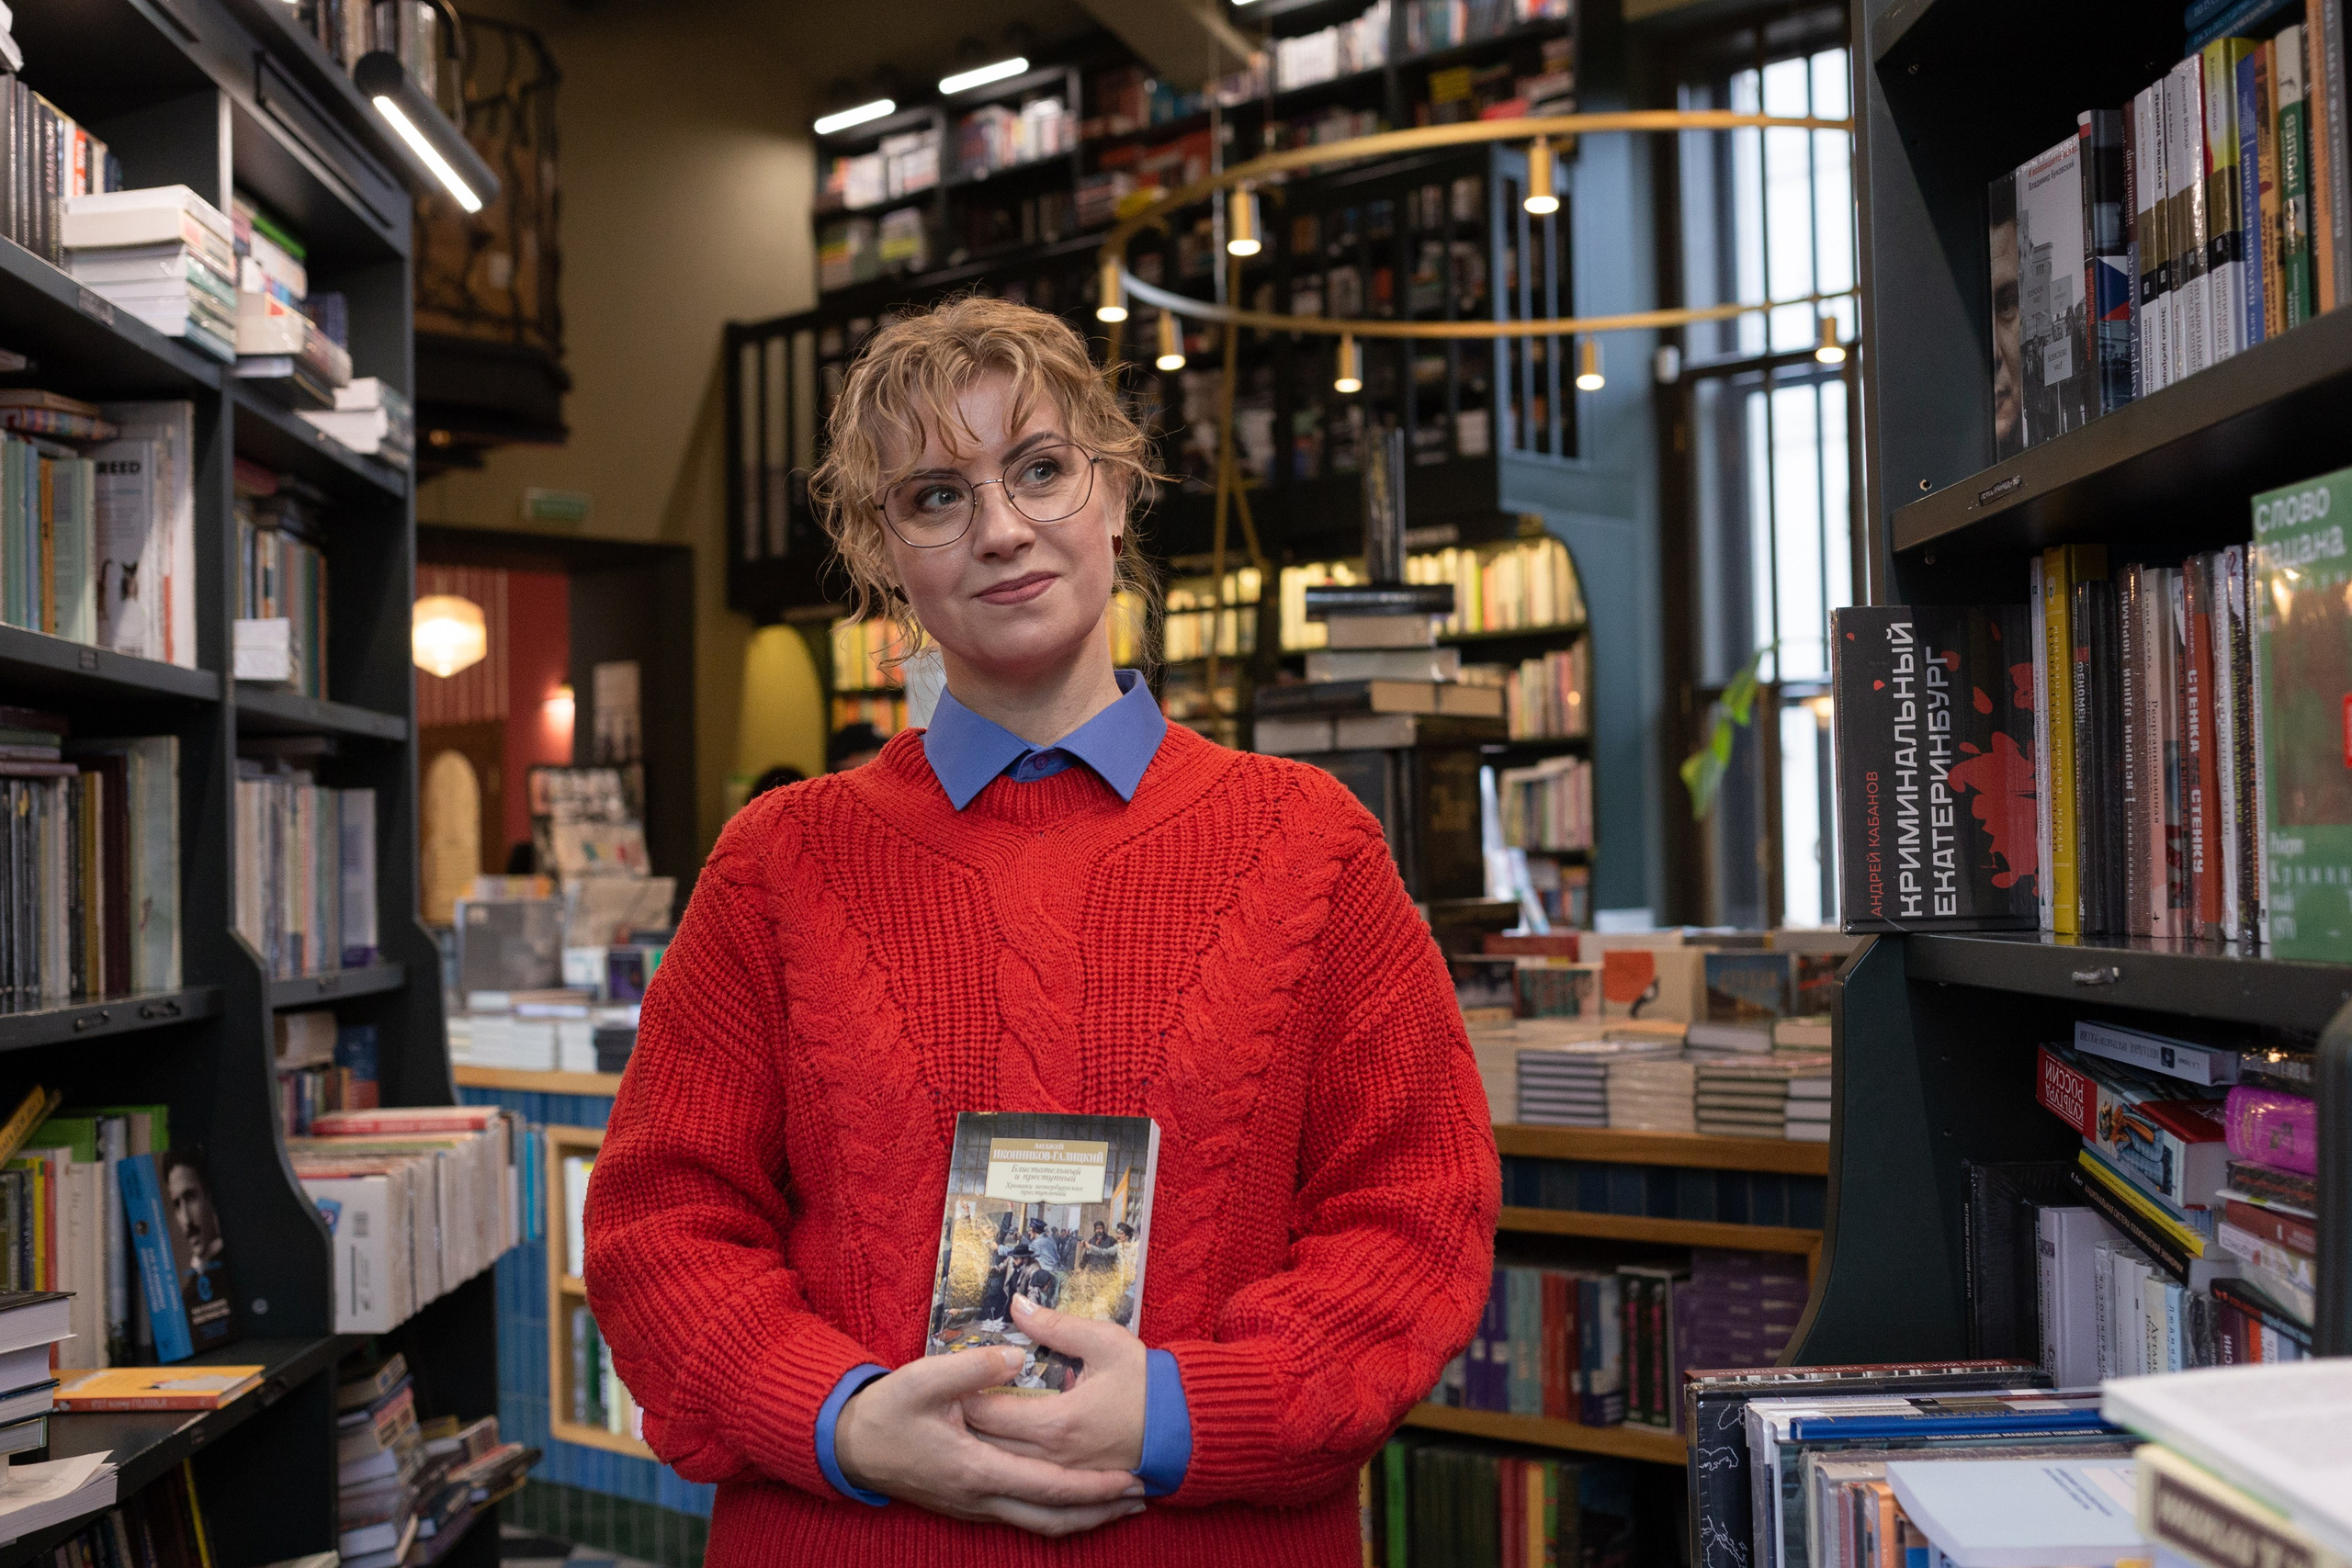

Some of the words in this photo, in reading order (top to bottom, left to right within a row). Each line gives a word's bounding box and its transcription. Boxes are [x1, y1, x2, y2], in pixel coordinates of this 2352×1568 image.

[2029, 174, 2050, 191] Владимир
[2051, 159, 2075, 181] Буковский
[2284, 113, 2299, 193] ТРОШЕВ
[2121, 590, 2131, 660] ТЮРЬМЫ
[2077, 661, 2086, 724] ФЕНОМЕН
[2123, 667, 2133, 717] ОДНОЙ
[2188, 669, 2200, 753] СТЕНКА
[1886, 621, 1922, 917] КРИМИНАЛЬНЫЙ
[1926, 646, 1957, 916] ЕКАТЕРИНБУРГ
[2125, 723, 2133, 790] ИСТОРИИ
[1866, 771, 1881, 847] КАБАНОВ
[2191, 789, 2204, 873] СТЕНКУ
[1866, 852, 1884, 917] АНДРЕЙ
[2045, 1060, 2084, 1103] РОССИИ
[2045, 1081, 2084, 1123] КУЛЬТУРА
[993, 1150, 1103, 1164] ИКОННИКОВ-ГАЛИЦКИЙ
[1006, 1182, 1033, 1191] Хроники
[1035, 1184, 1083, 1193] петербургских
[1011, 1164, 1081, 1175] Блистательный
[1023, 1174, 1076, 1183] преступный
